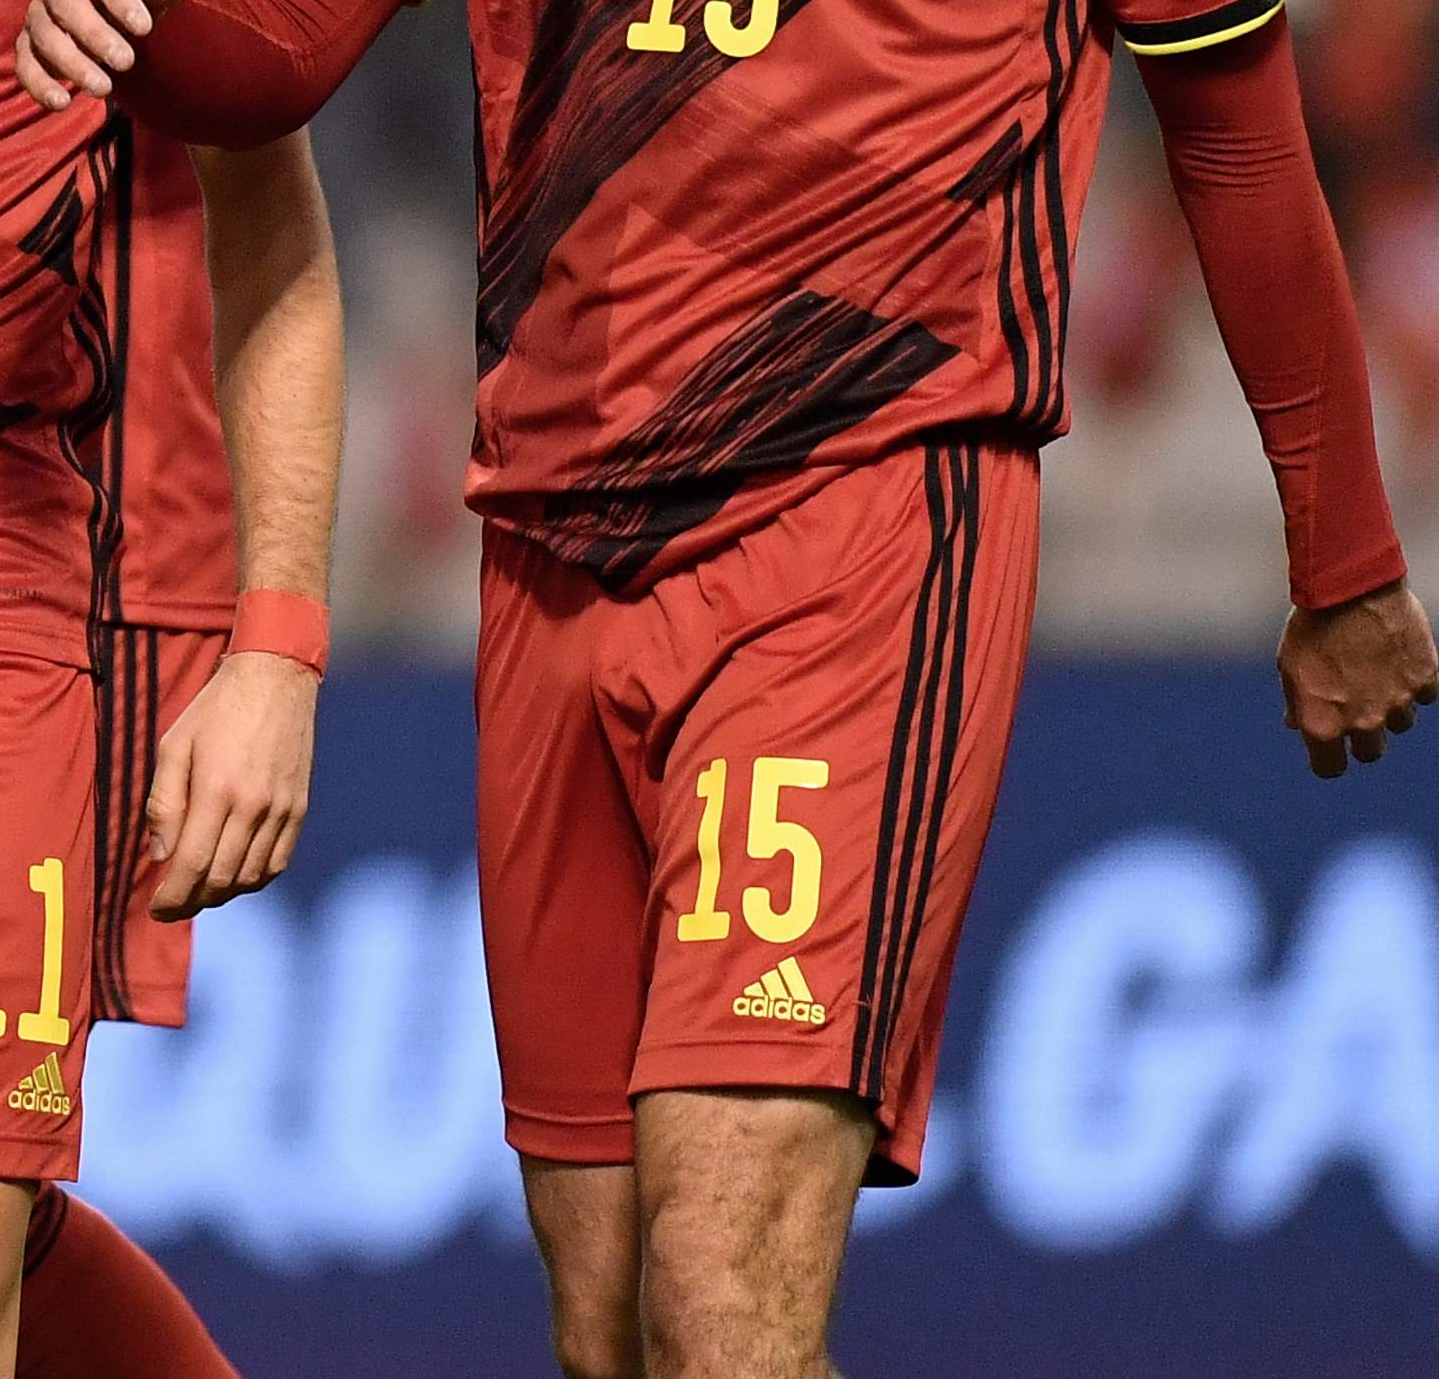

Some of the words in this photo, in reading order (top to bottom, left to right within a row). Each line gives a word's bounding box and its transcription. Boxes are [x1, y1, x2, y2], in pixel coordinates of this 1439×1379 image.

[677, 756, 830, 943] 15
[732, 993, 826, 1025] adidas
[8, 1087, 72, 1116] adidas
